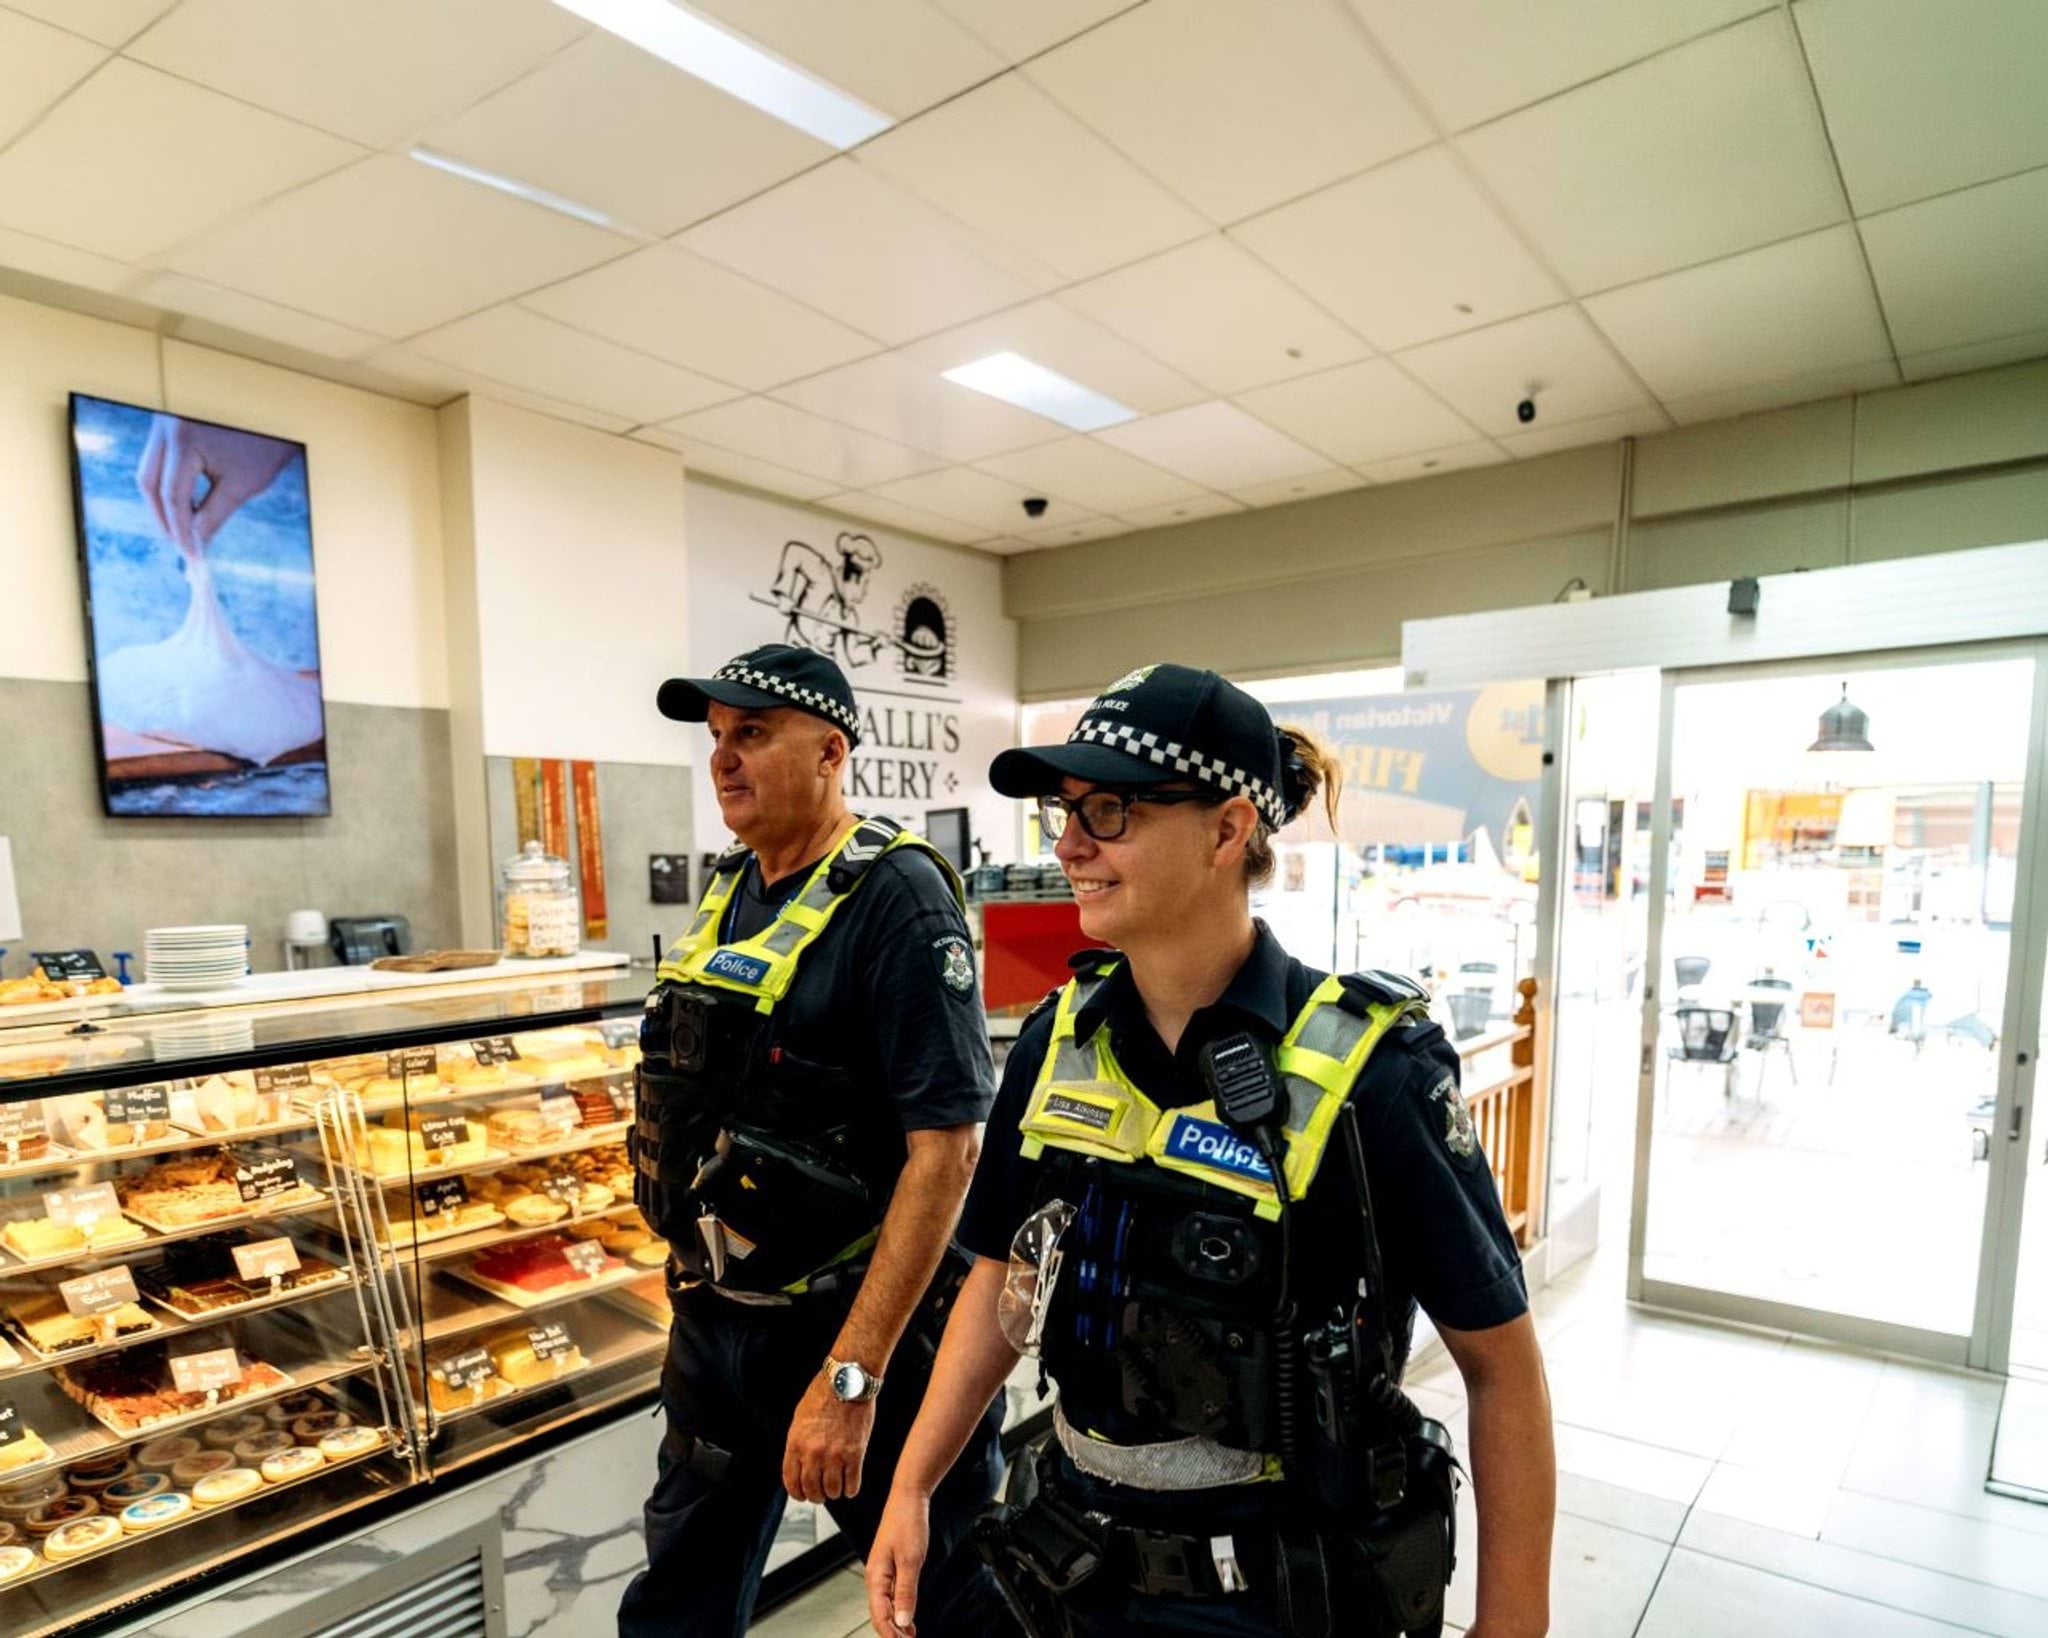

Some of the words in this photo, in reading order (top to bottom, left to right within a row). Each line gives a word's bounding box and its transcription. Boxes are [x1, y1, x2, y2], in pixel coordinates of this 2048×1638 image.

[857, 705, 960, 753] ALLI'S
[841, 757, 938, 799] KERY
[711, 952, 758, 979] Police
[127, 1088, 161, 1102] Muffin
[1053, 1097, 1070, 1110] Lisa
